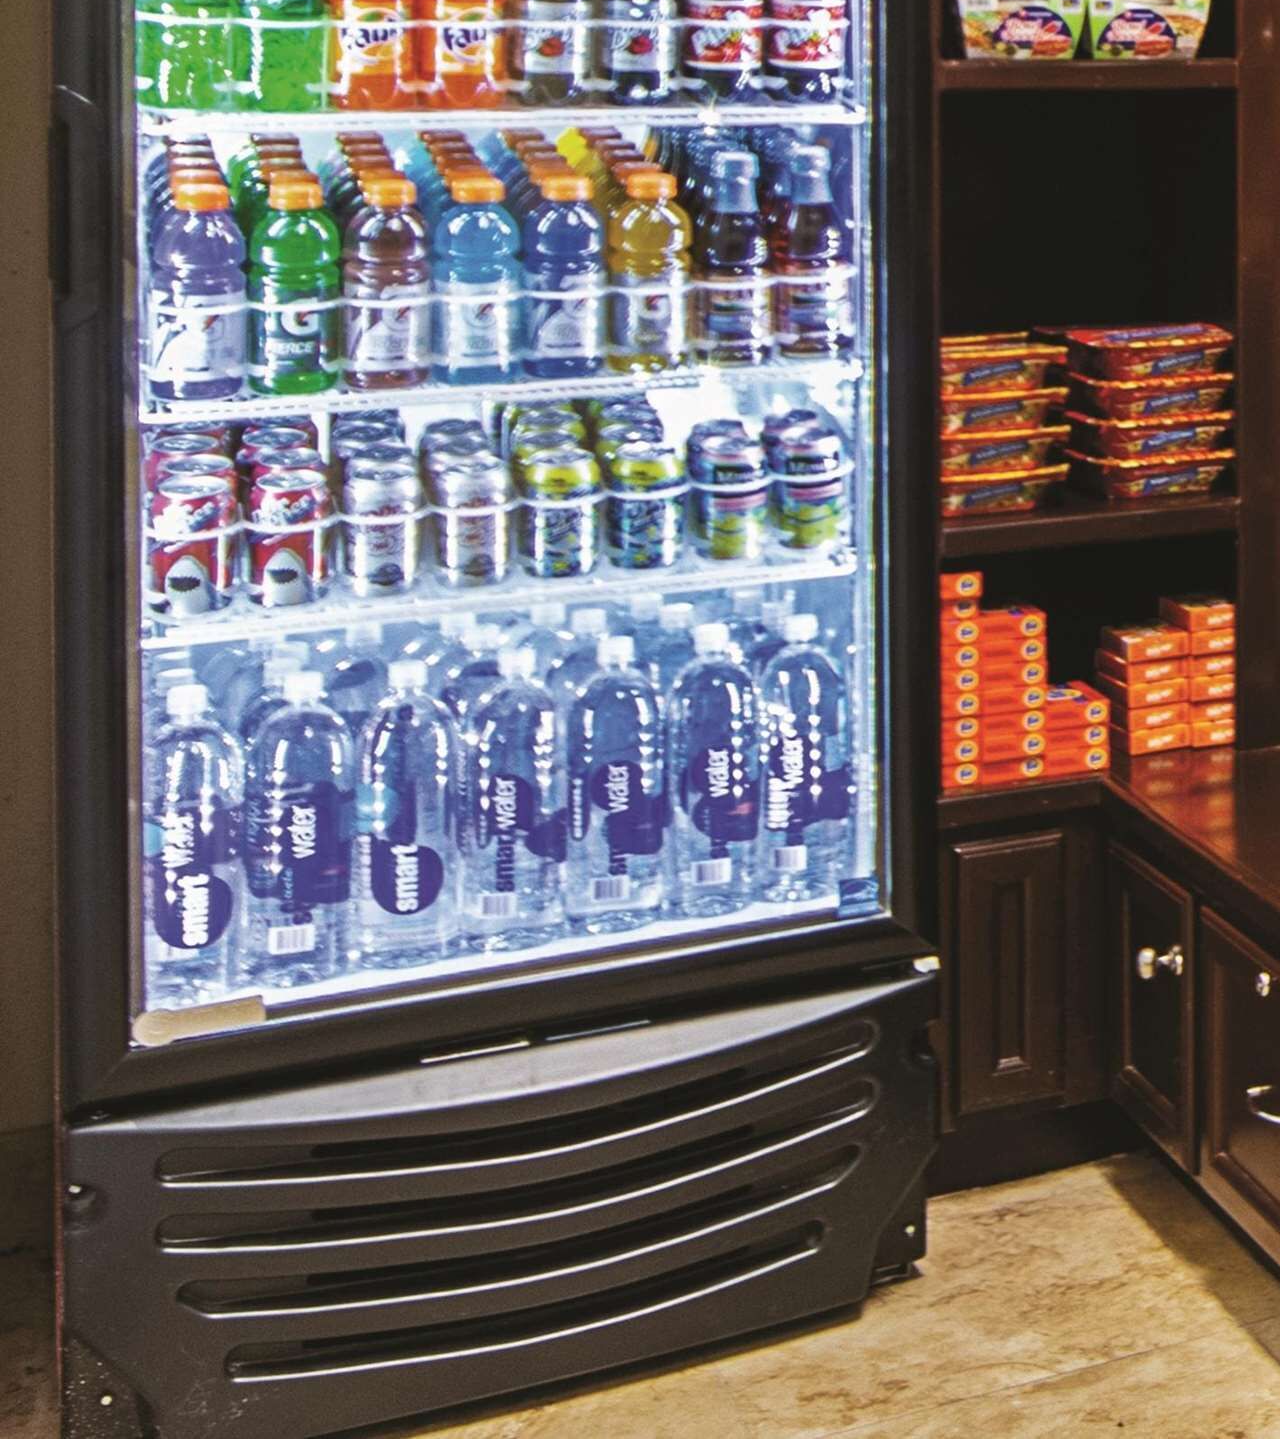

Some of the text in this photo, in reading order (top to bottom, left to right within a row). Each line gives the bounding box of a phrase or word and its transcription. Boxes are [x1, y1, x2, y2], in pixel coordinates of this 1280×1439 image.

[608, 765, 630, 814] water
[708, 749, 730, 798] water
[491, 777, 518, 828] water
[289, 805, 317, 859] water
[391, 843, 419, 913] smart
